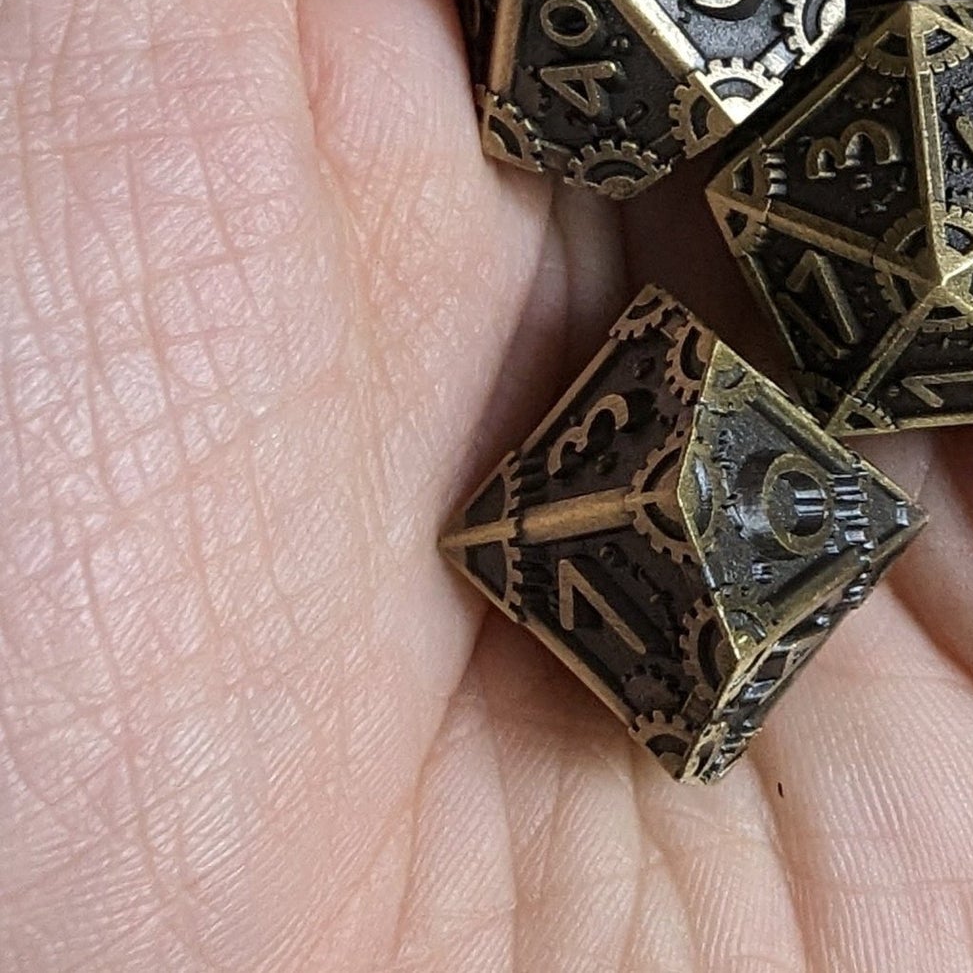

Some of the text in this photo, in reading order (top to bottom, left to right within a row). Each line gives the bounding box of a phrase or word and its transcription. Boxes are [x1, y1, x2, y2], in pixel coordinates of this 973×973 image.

[807, 118, 899, 181] 3
[547, 393, 629, 476] 3
[762, 453, 834, 555] 0
[557, 558, 647, 655] 7
